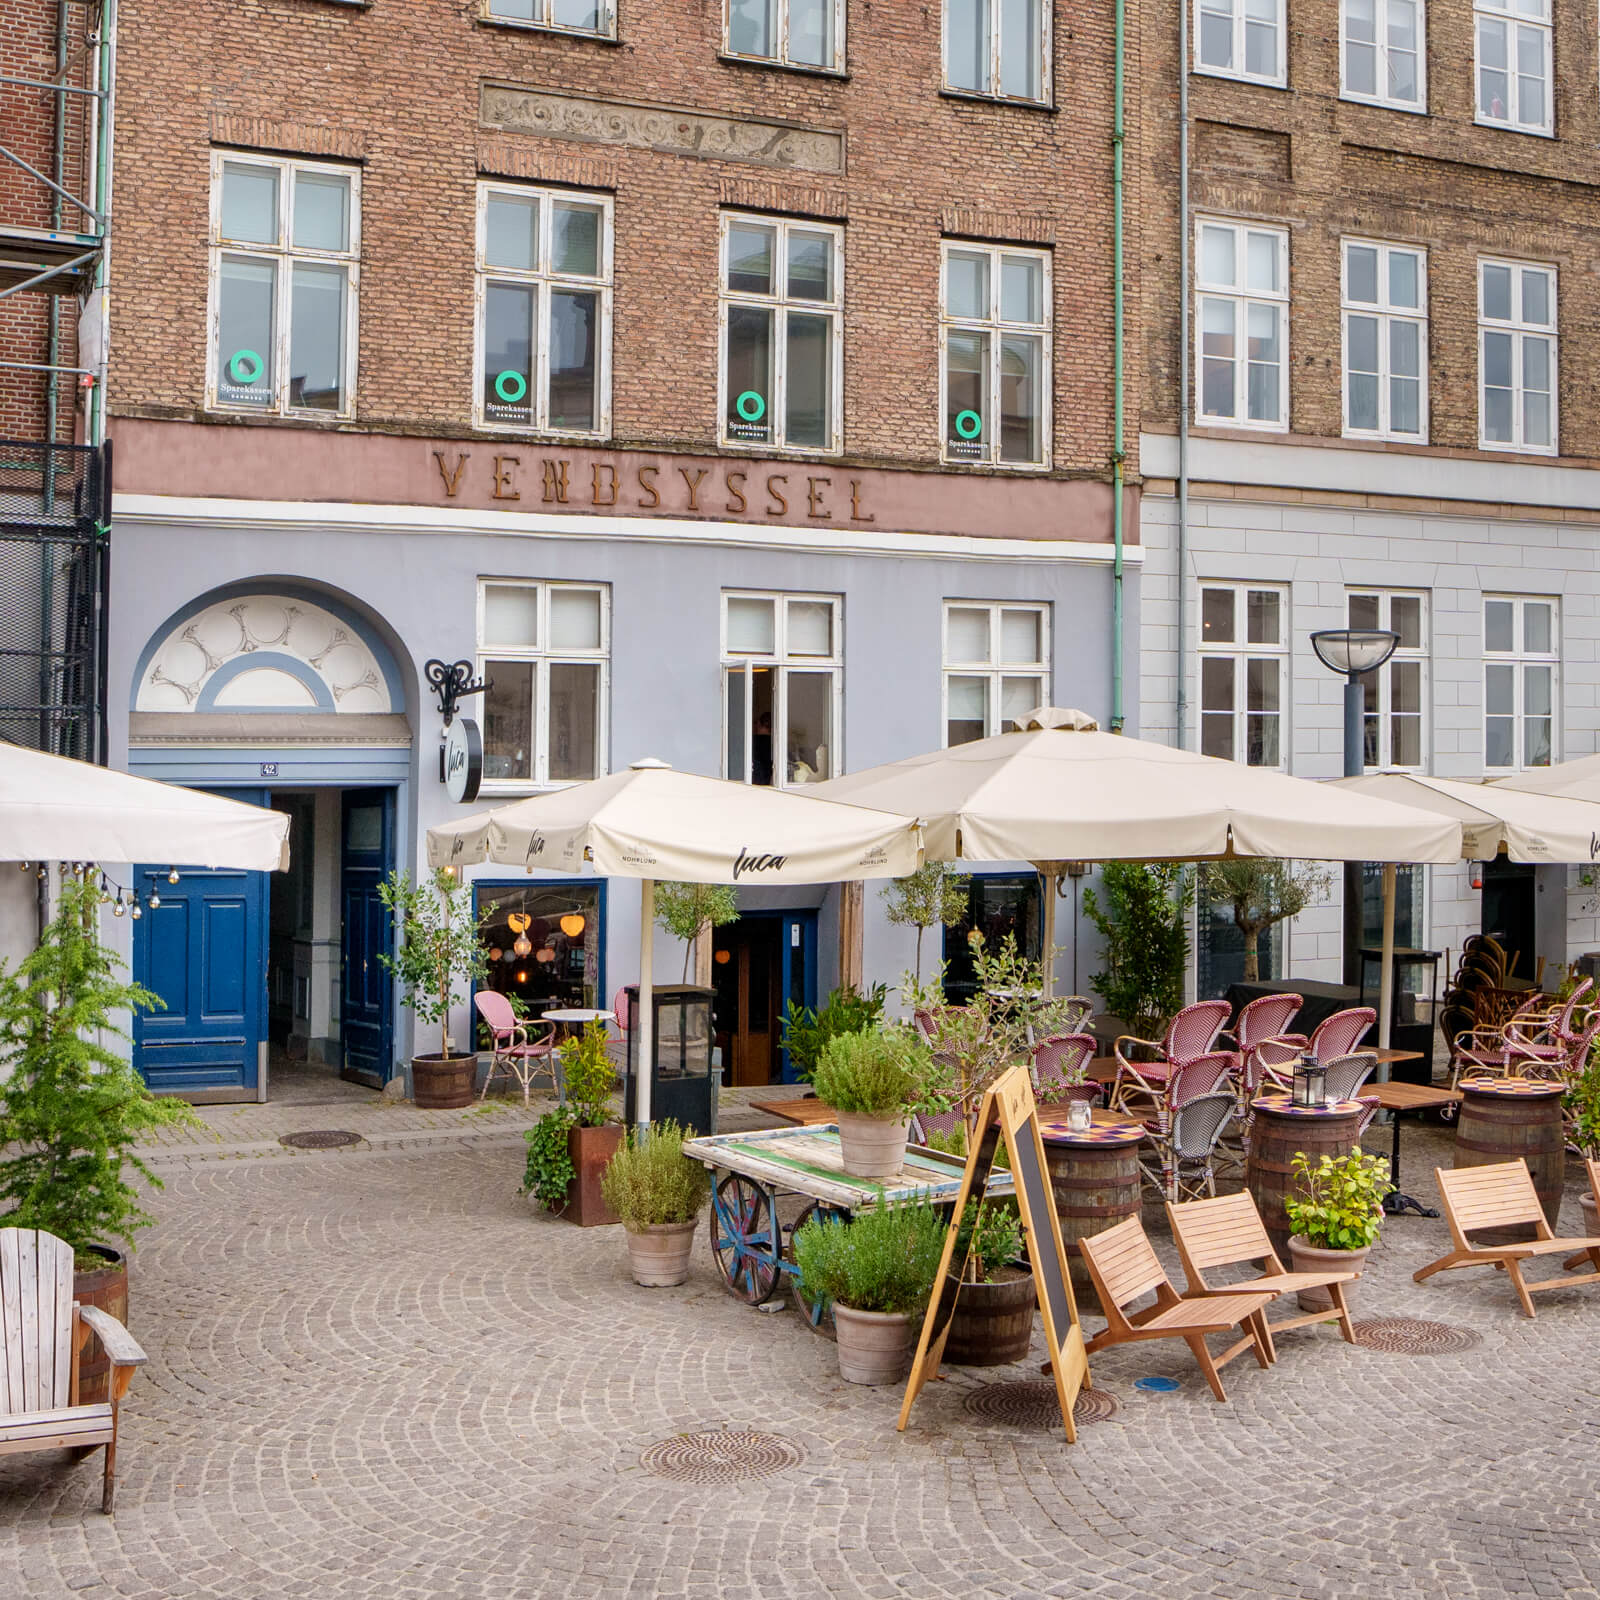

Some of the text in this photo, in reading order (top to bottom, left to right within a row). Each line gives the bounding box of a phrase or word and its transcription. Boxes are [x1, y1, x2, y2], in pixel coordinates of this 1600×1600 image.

[220, 383, 273, 395] Sparekassen
[487, 402, 534, 414] Sparekassen
[729, 421, 771, 432] Sparekassen
[949, 439, 988, 449] Sparekassen
[432, 450, 875, 523] VENDSYSSEL
[263, 764, 275, 774] 42
[733, 846, 788, 881] luca
